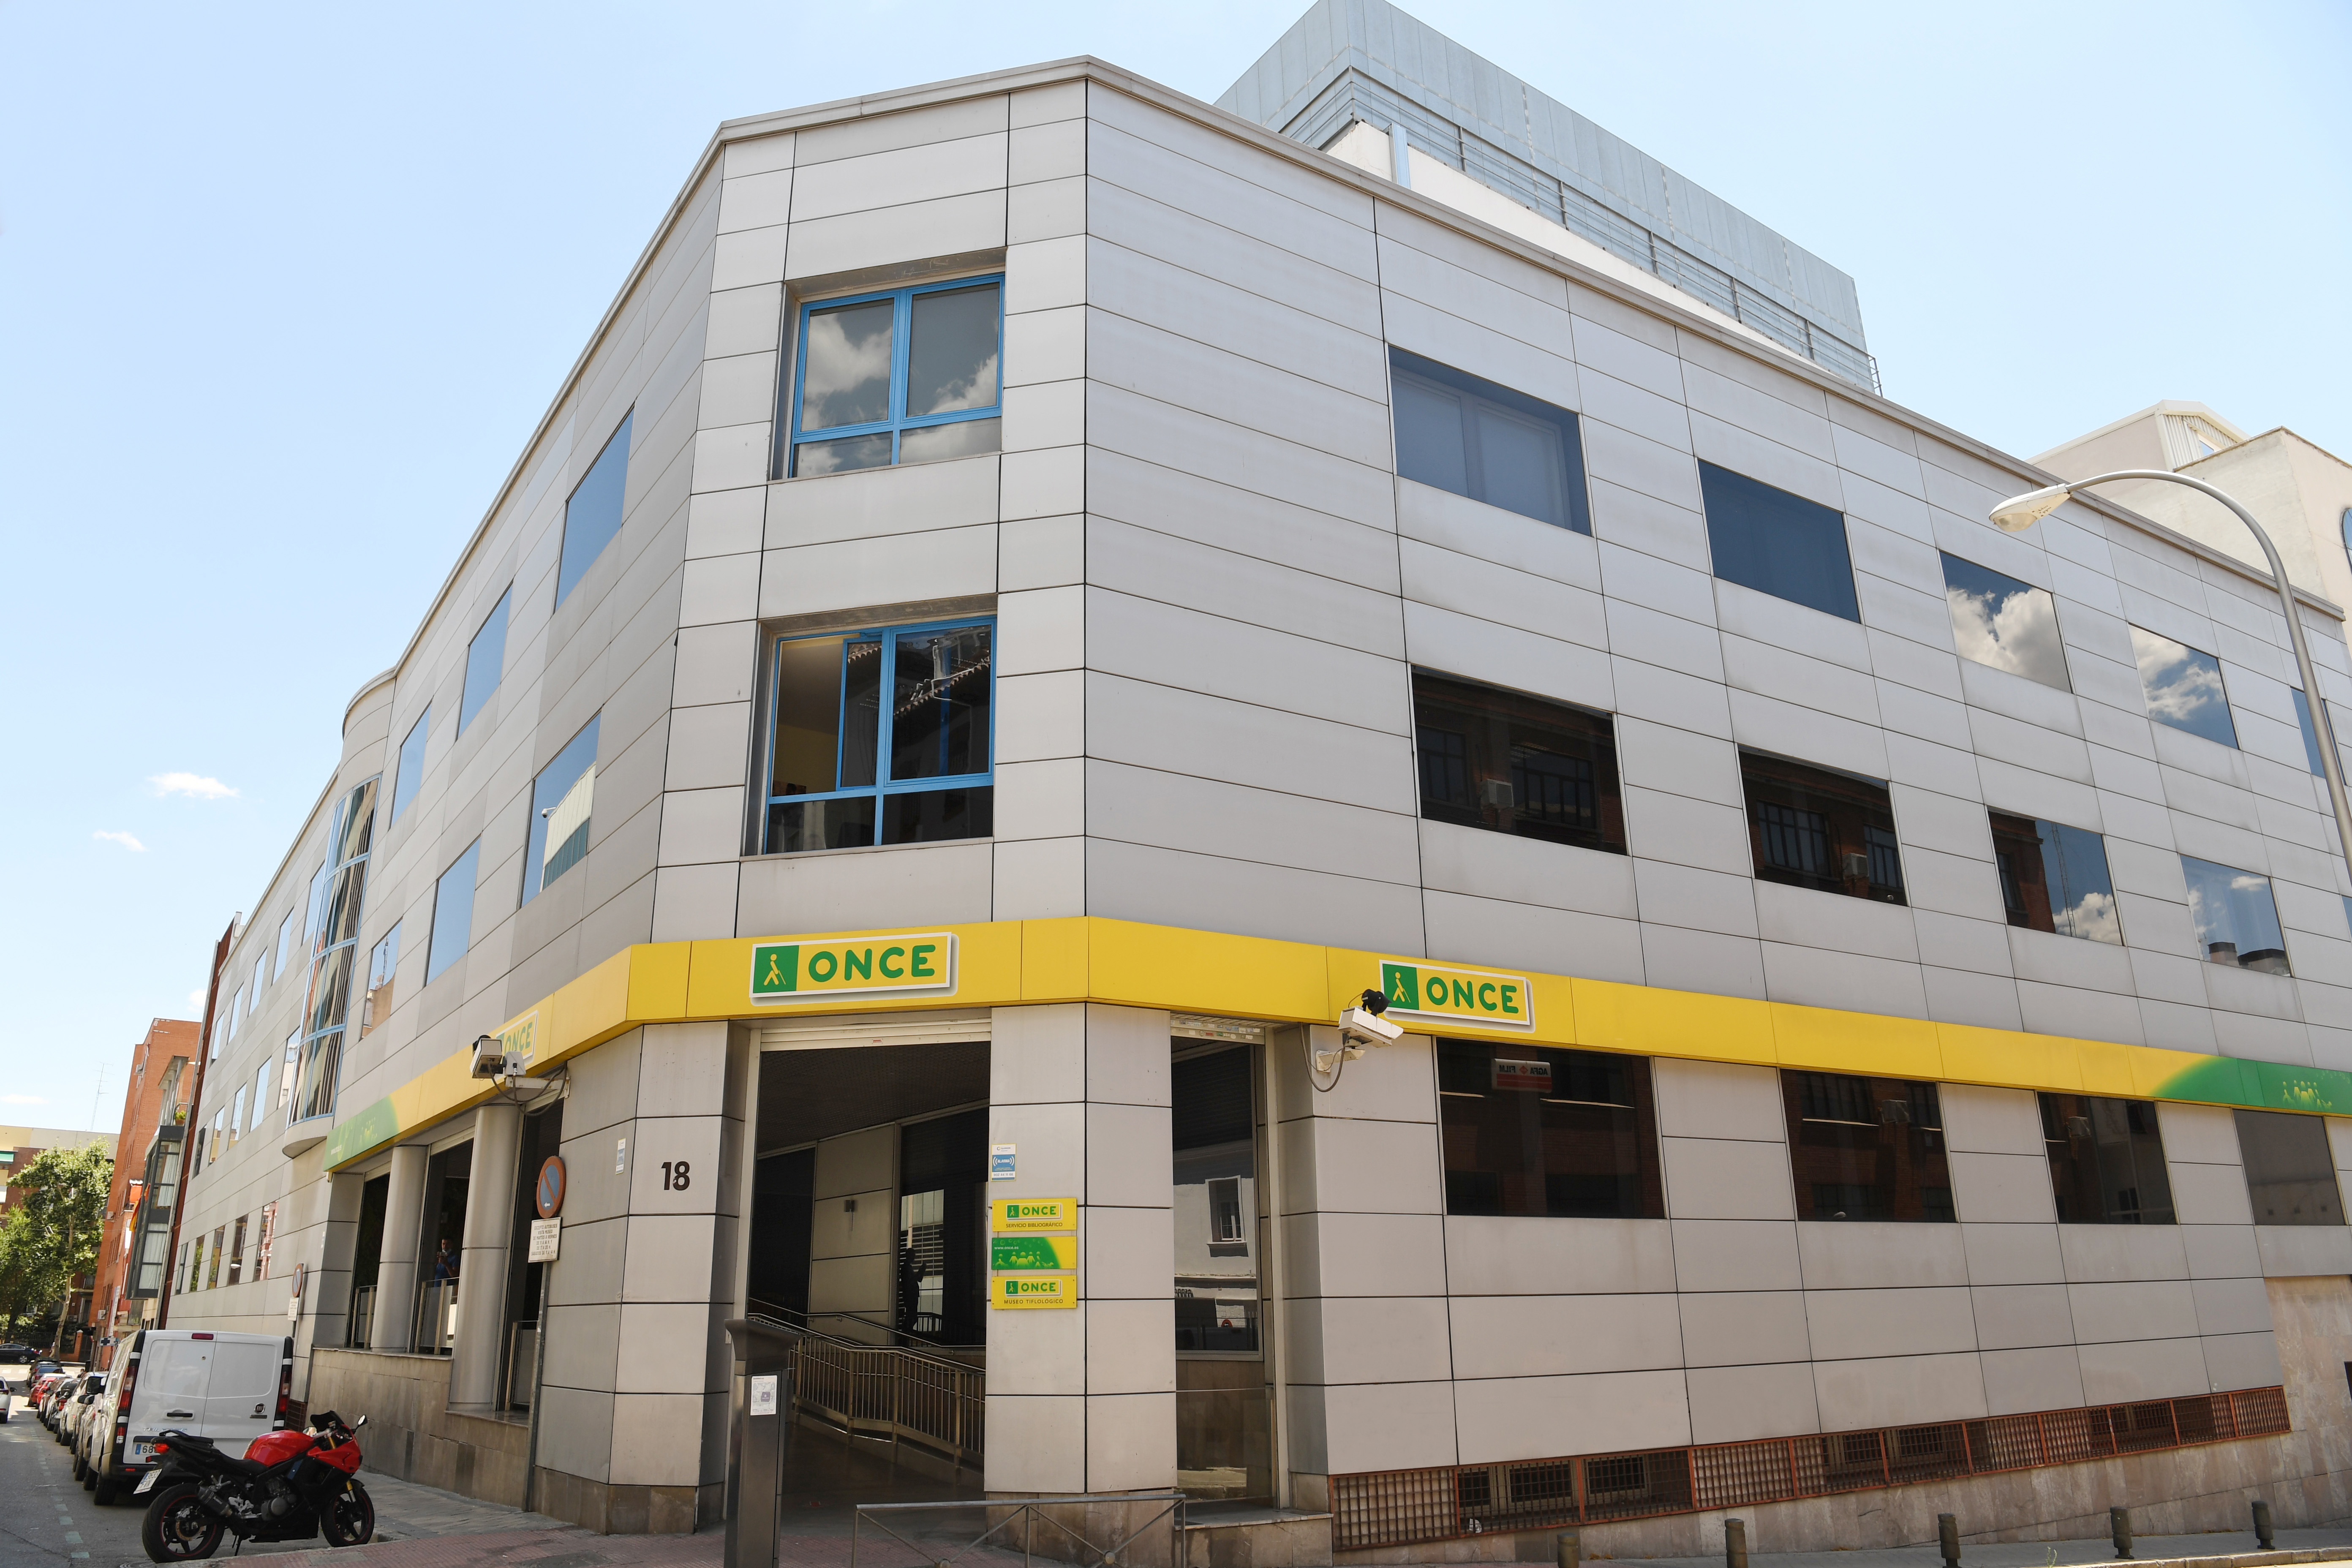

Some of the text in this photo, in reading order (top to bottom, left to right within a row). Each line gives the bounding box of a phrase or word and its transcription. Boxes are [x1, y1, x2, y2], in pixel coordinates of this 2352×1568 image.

[808, 945, 935, 982] ONCE
[1426, 977, 1519, 1013] ONCE
[504, 1021, 532, 1055] ONCE
[661, 1161, 690, 1191] 18
[1022, 1206, 1056, 1216] ONCE
[1021, 1282, 1056, 1292] ONCE
